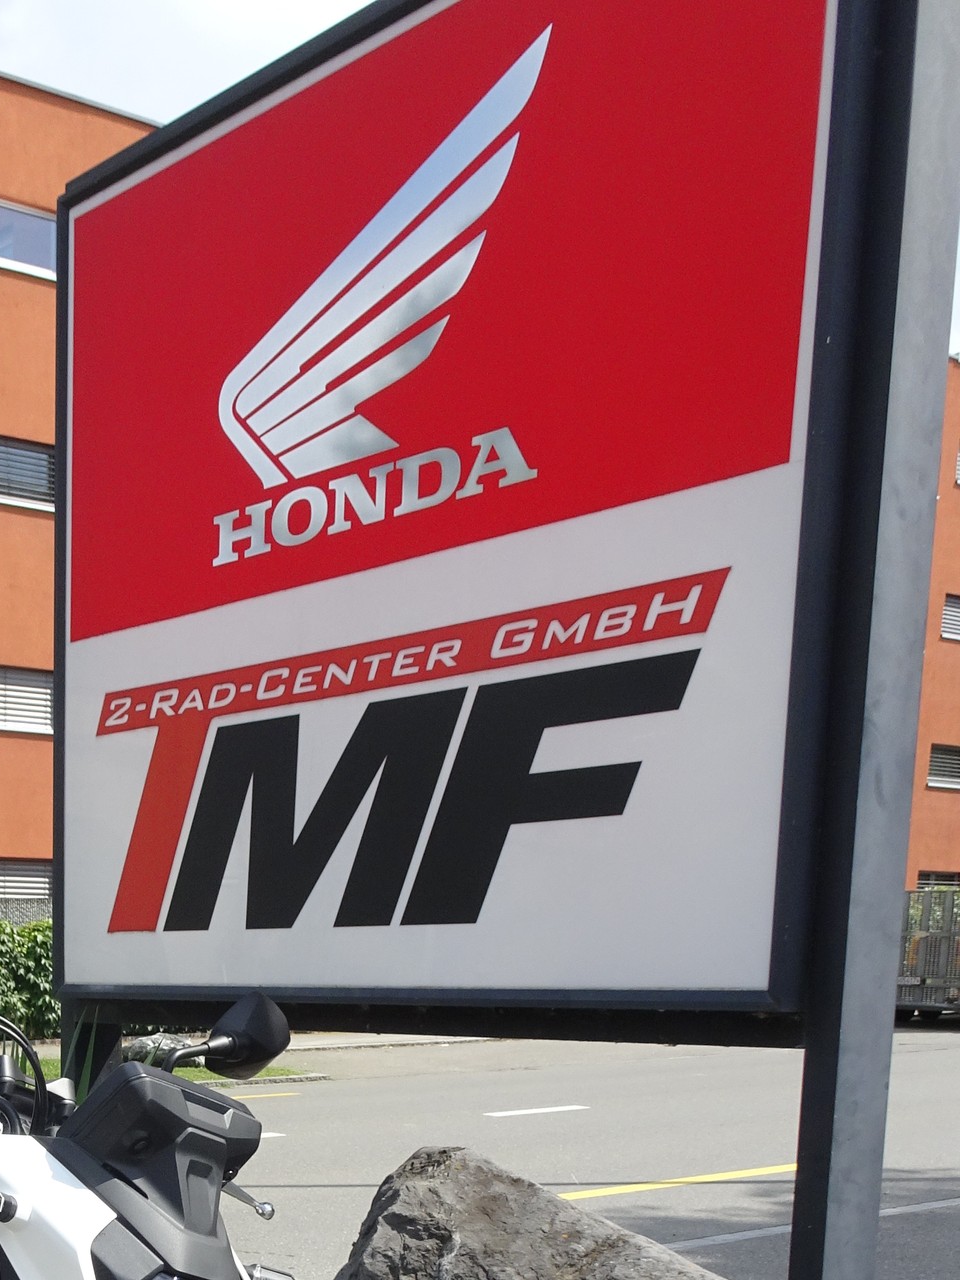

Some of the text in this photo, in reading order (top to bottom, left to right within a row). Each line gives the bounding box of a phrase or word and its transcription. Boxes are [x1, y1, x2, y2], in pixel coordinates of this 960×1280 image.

[212, 426, 538, 567] HONDA
[105, 638, 463, 728] 2-RAD-CENTER
[106, 648, 702, 934] TMF
